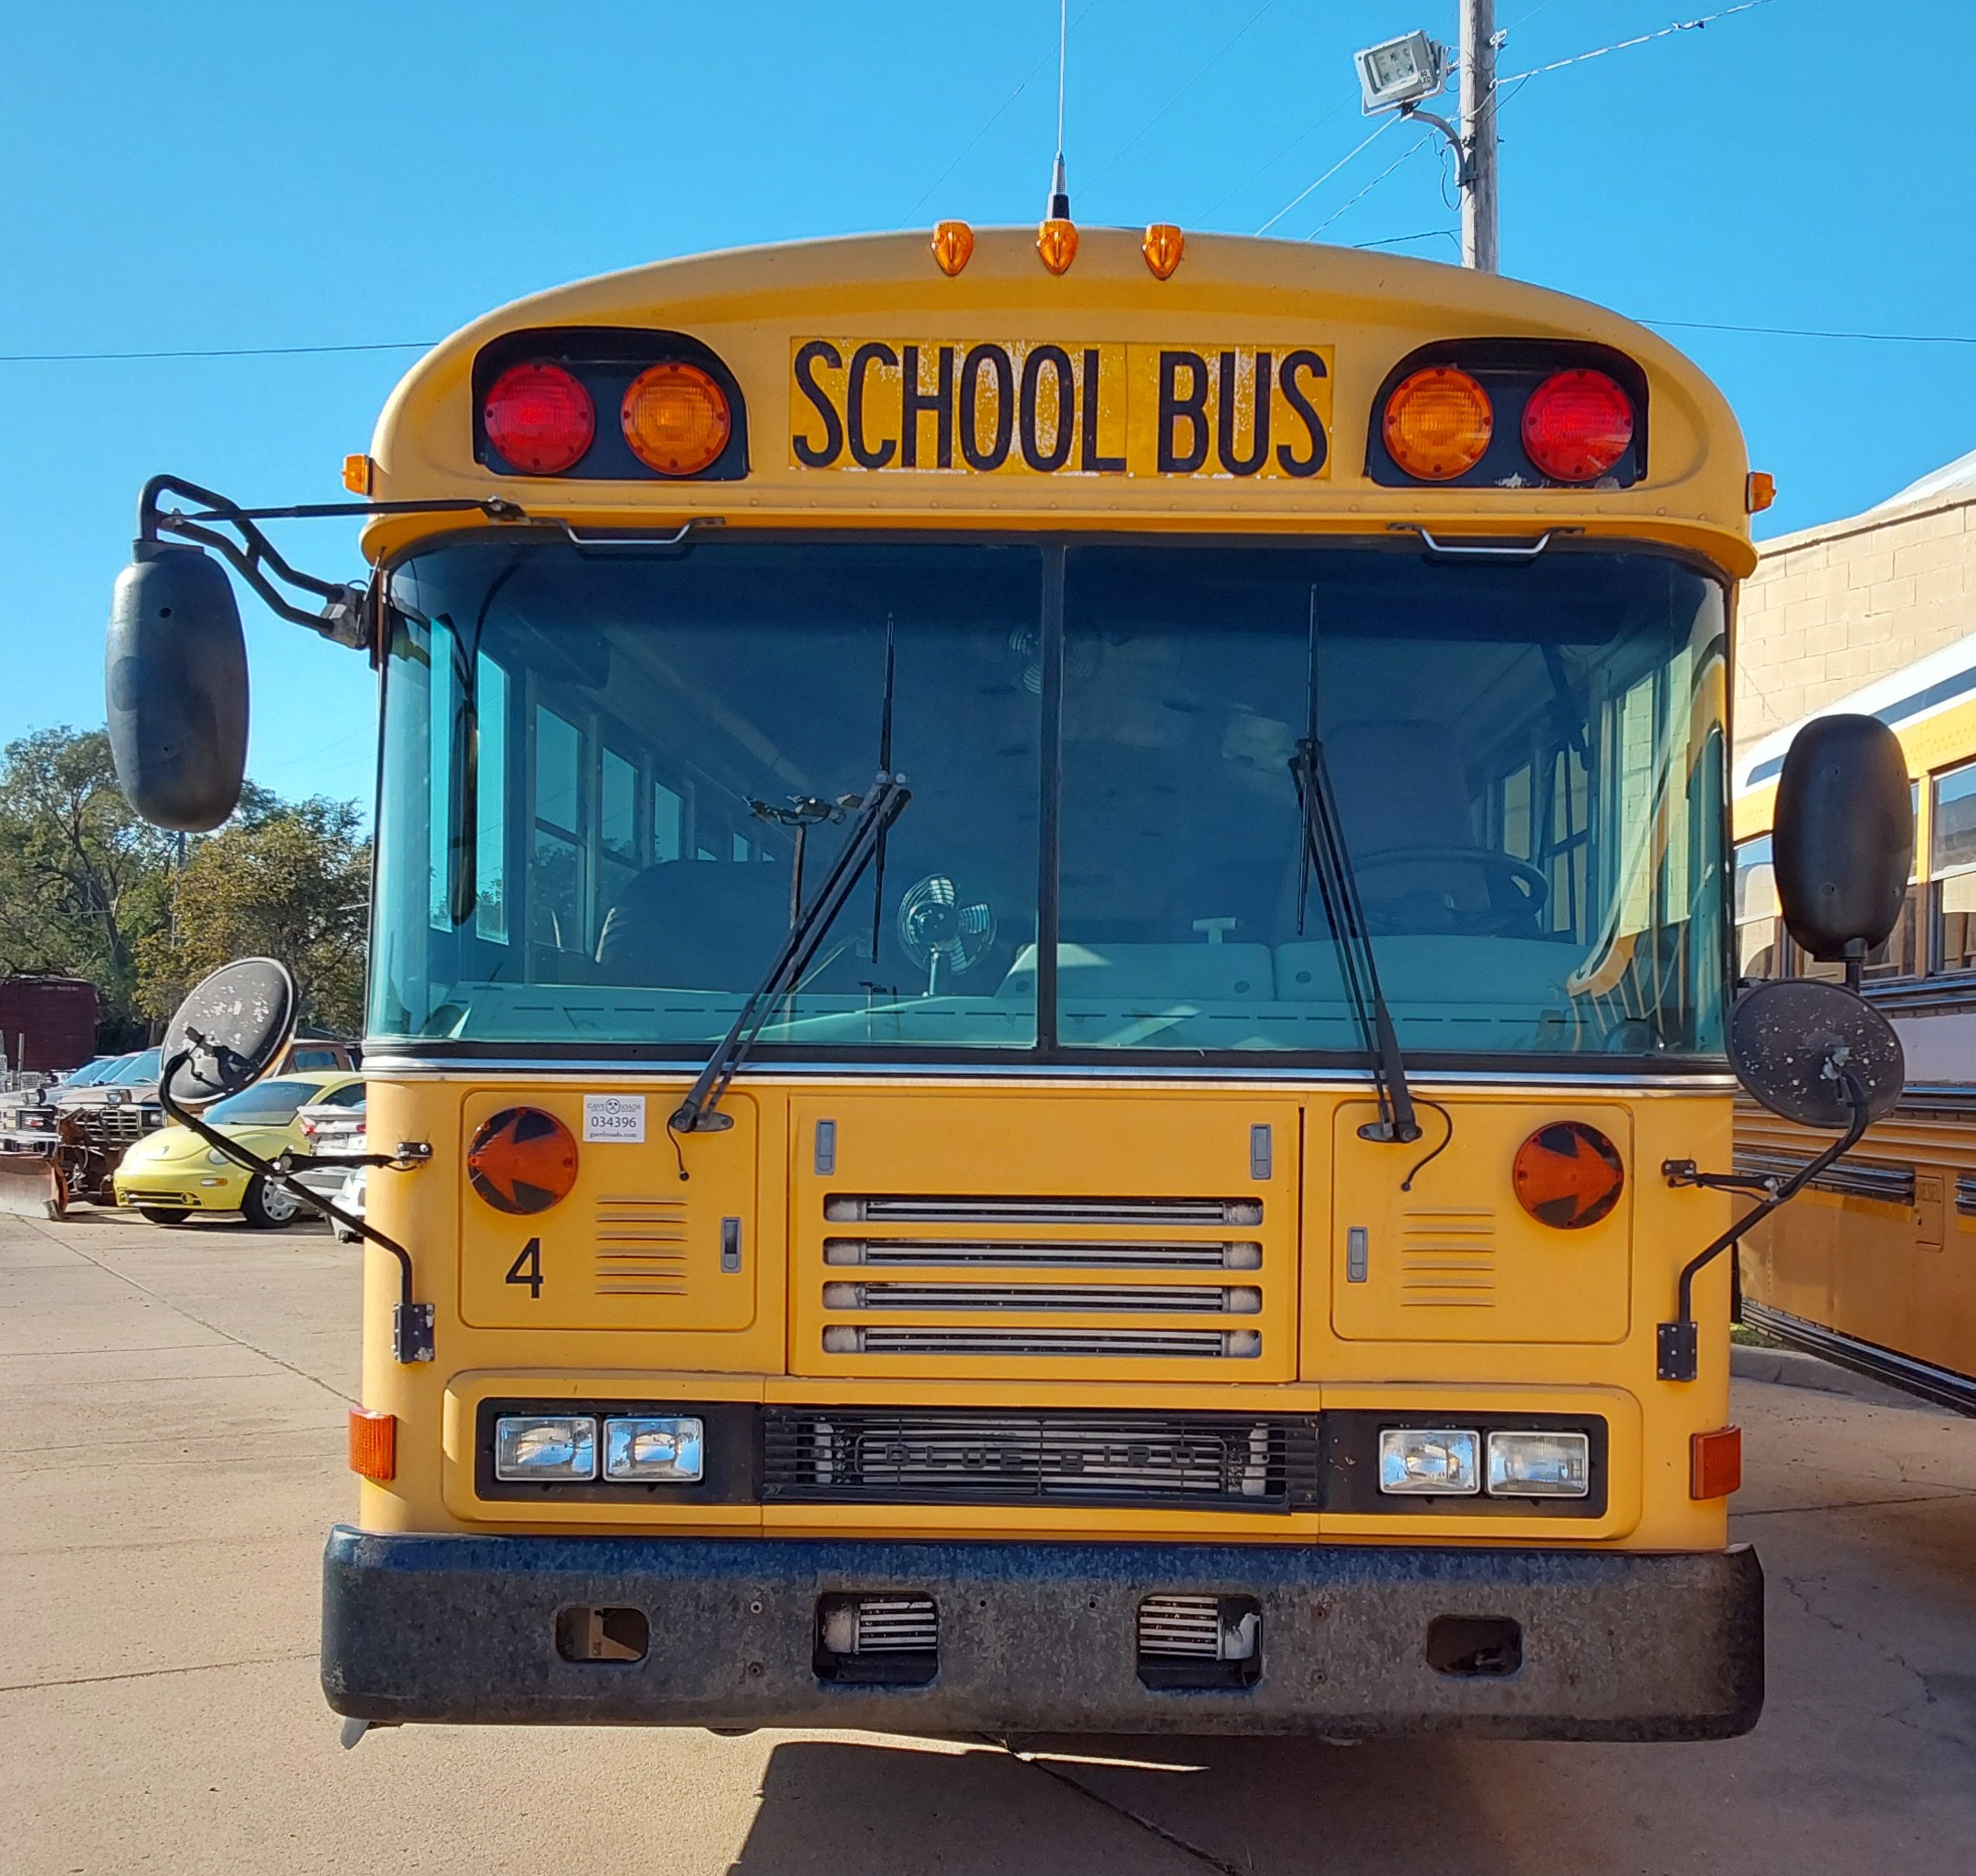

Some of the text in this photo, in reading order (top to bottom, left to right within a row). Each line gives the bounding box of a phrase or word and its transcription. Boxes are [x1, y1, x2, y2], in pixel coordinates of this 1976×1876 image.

[792, 341, 1329, 478] SCHOOL BUS
[591, 1116, 636, 1127] 034396
[505, 1237, 544, 1299] 4
[886, 1444, 1195, 1472] BLUE BIRD
